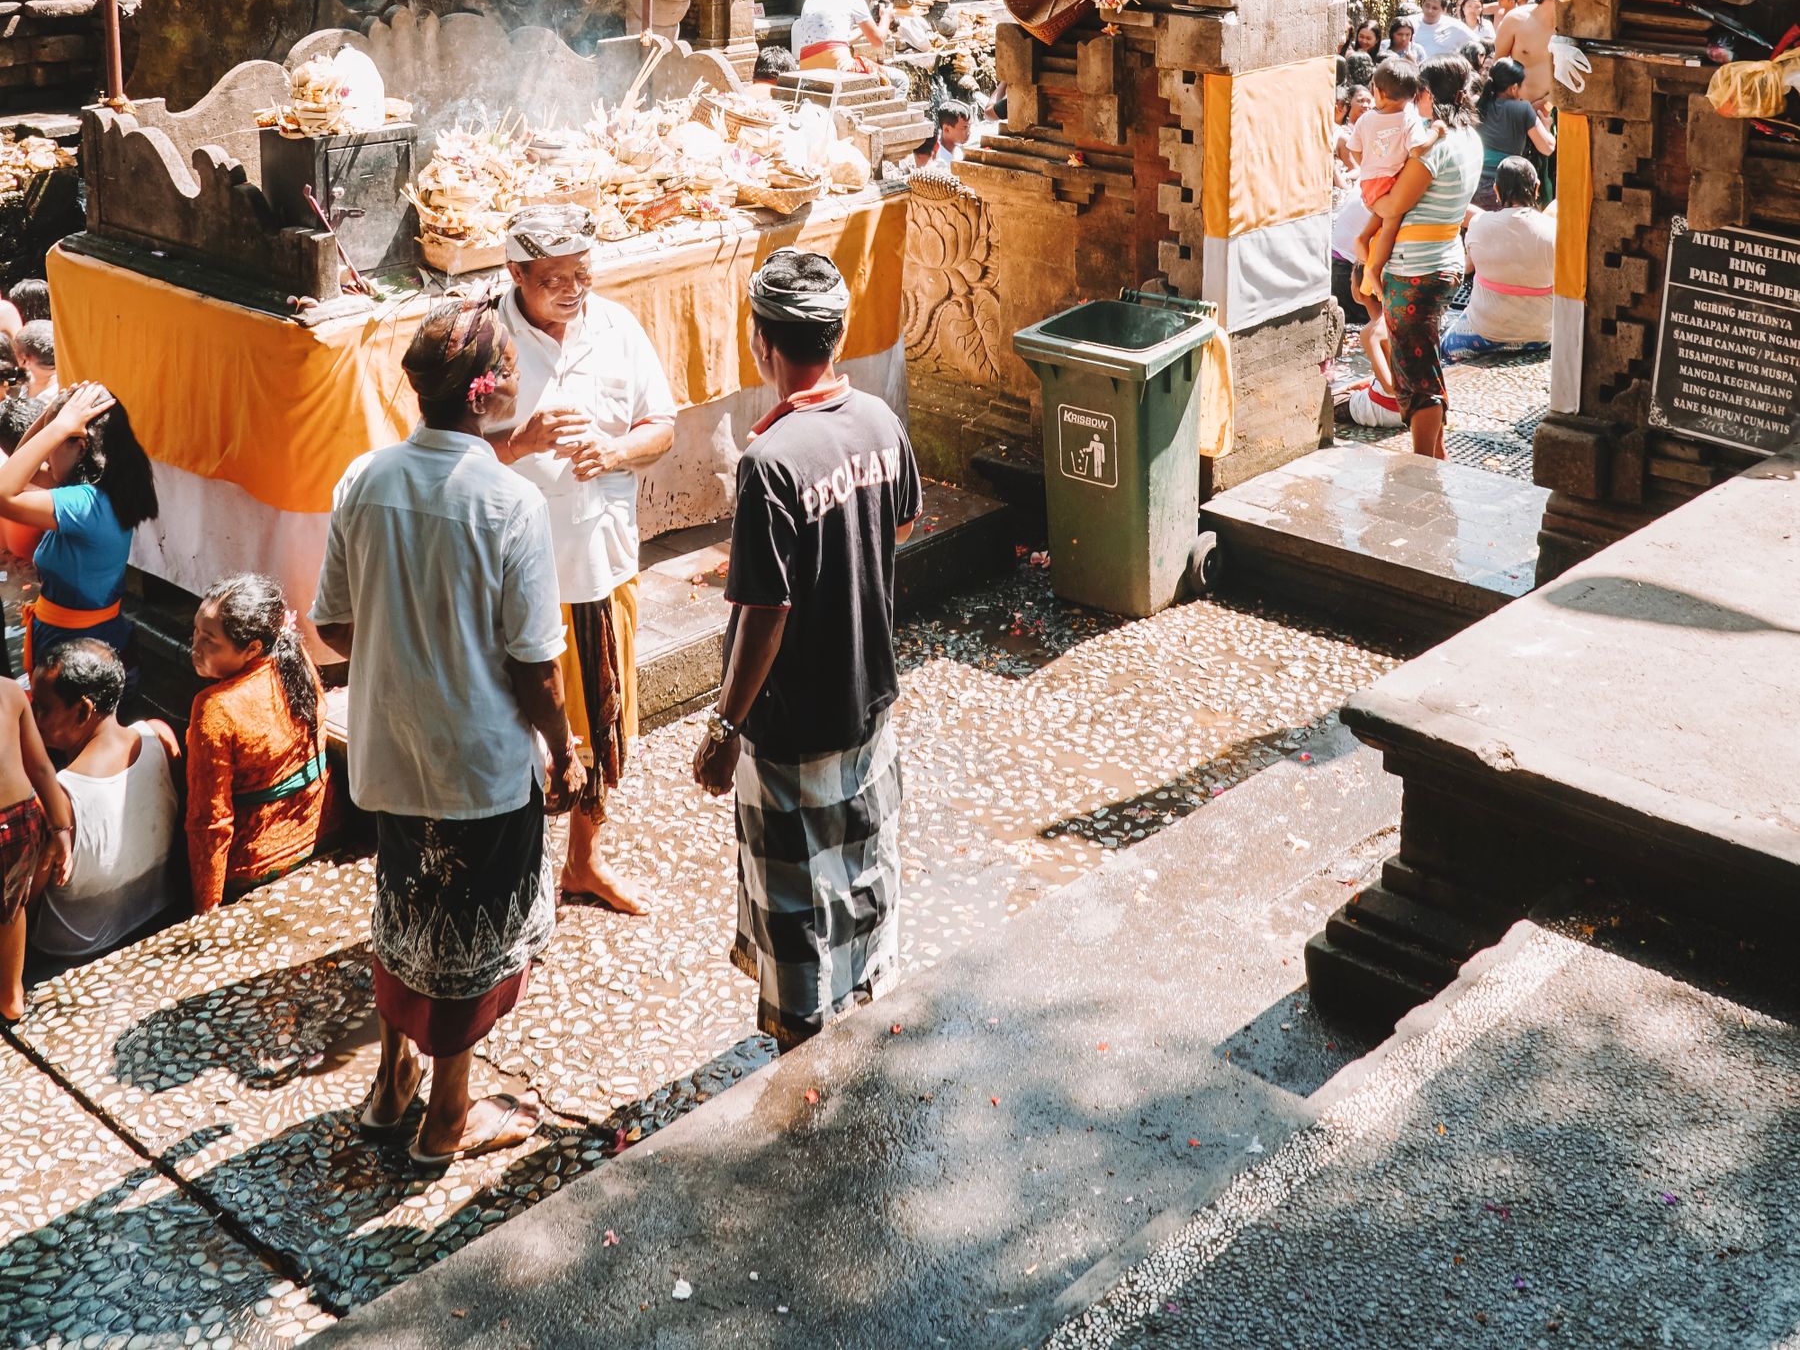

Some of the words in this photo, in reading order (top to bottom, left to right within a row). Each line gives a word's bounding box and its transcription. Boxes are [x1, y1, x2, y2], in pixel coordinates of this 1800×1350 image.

[1692, 231, 1730, 250] ATUR
[1689, 267, 1729, 287] PARA
[1728, 257, 1767, 277] RING
[1693, 300, 1736, 318] NGIRING
[1670, 311, 1730, 334] MELARAPAN
[1731, 326, 1767, 342] ANTUK
[1768, 333, 1800, 351] NGAM
[1673, 330, 1713, 347] SAMPAH
[1714, 339, 1756, 357] CANANG
[1756, 349, 1762, 360] /
[1764, 350, 1800, 368] PLASTI
[1678, 347, 1736, 369] RISAMPUNE
[1737, 360, 1759, 375] WUS
[1760, 366, 1798, 386] MUSPA,
[1679, 365, 1721, 383] MANGDA
[1723, 375, 1793, 400] KEGENAHANG
[1673, 397, 1700, 413] SANE
[1700, 404, 1742, 423] SAMPUN
[1743, 415, 1791, 435] CUMAWIS
[1682, 382, 1707, 397] RING
[1708, 389, 1743, 406] GENAH
[1744, 398, 1786, 416] SAMPAH
[1063, 410, 1108, 430] KRISBOW
